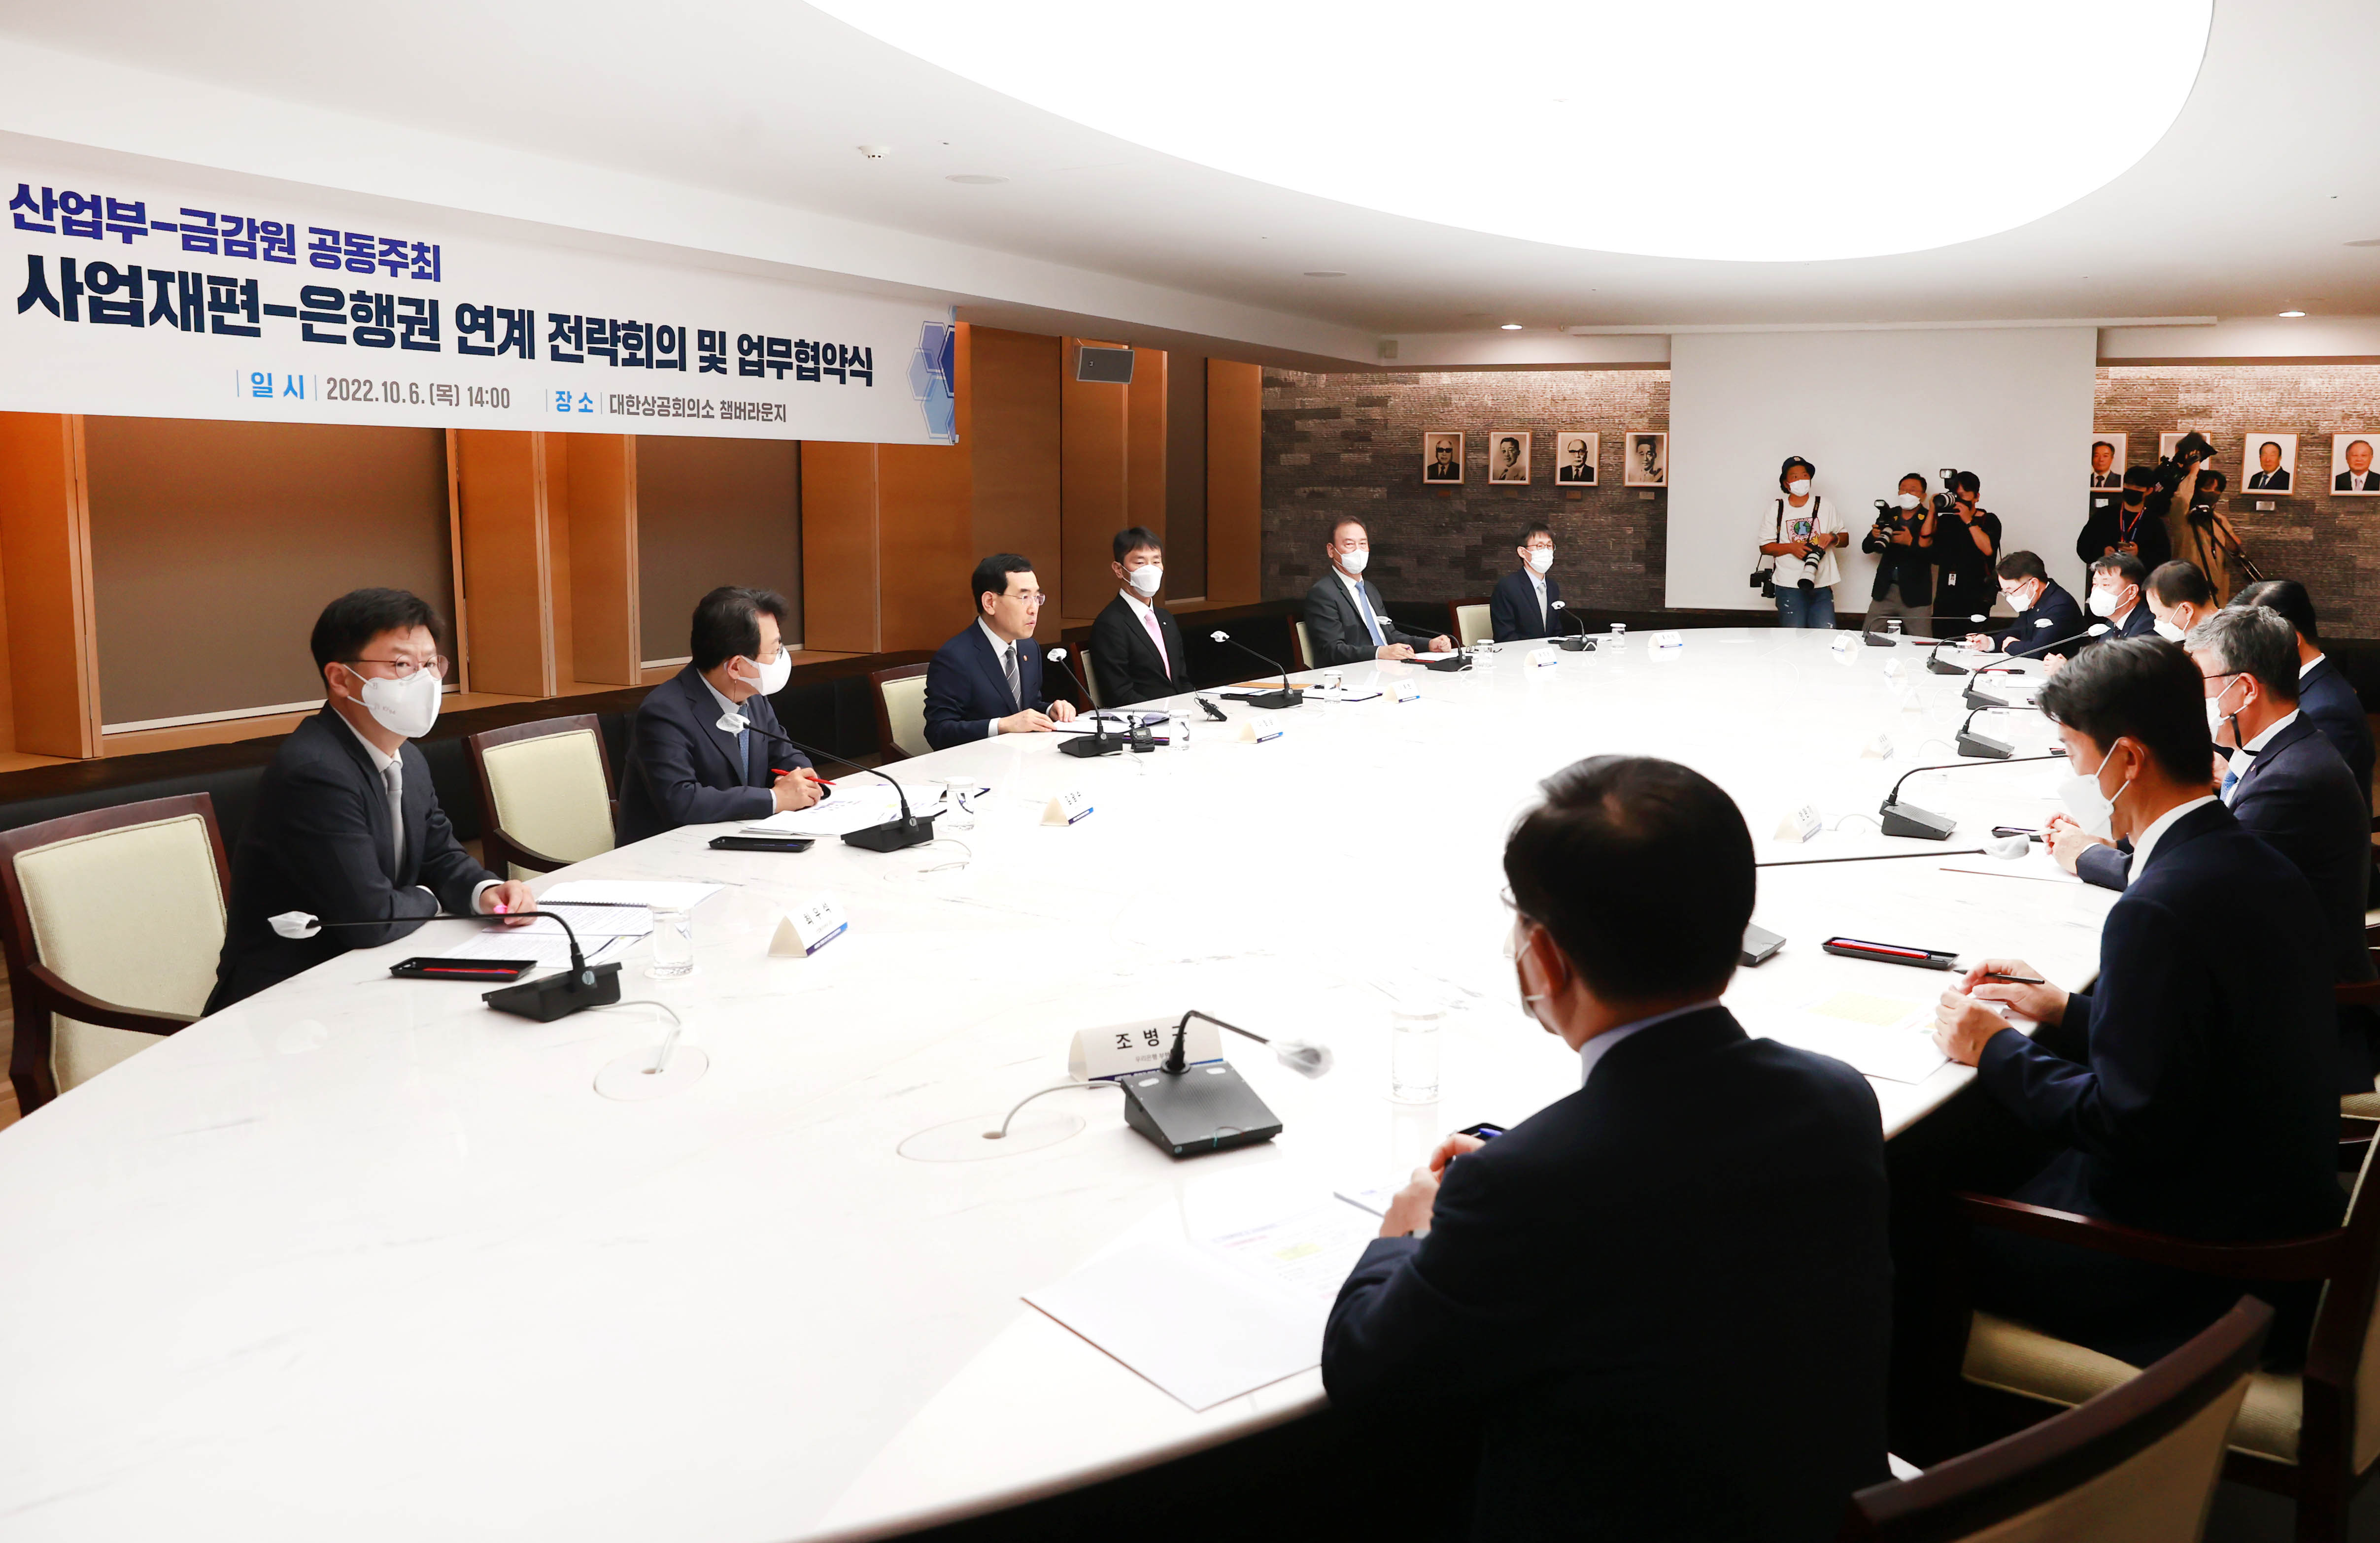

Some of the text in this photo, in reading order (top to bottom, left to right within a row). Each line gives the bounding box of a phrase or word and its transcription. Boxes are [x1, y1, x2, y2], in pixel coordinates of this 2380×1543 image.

[9, 183, 441, 282] 산업부-금감원 공동주최
[17, 254, 873, 387] 사업재편-은행권 연계 전략회의 및 업무협약식
[468, 386, 510, 409] 14:00
[610, 394, 715, 419] 대한상공회의소
[720, 400, 786, 423] 챔버라운지
